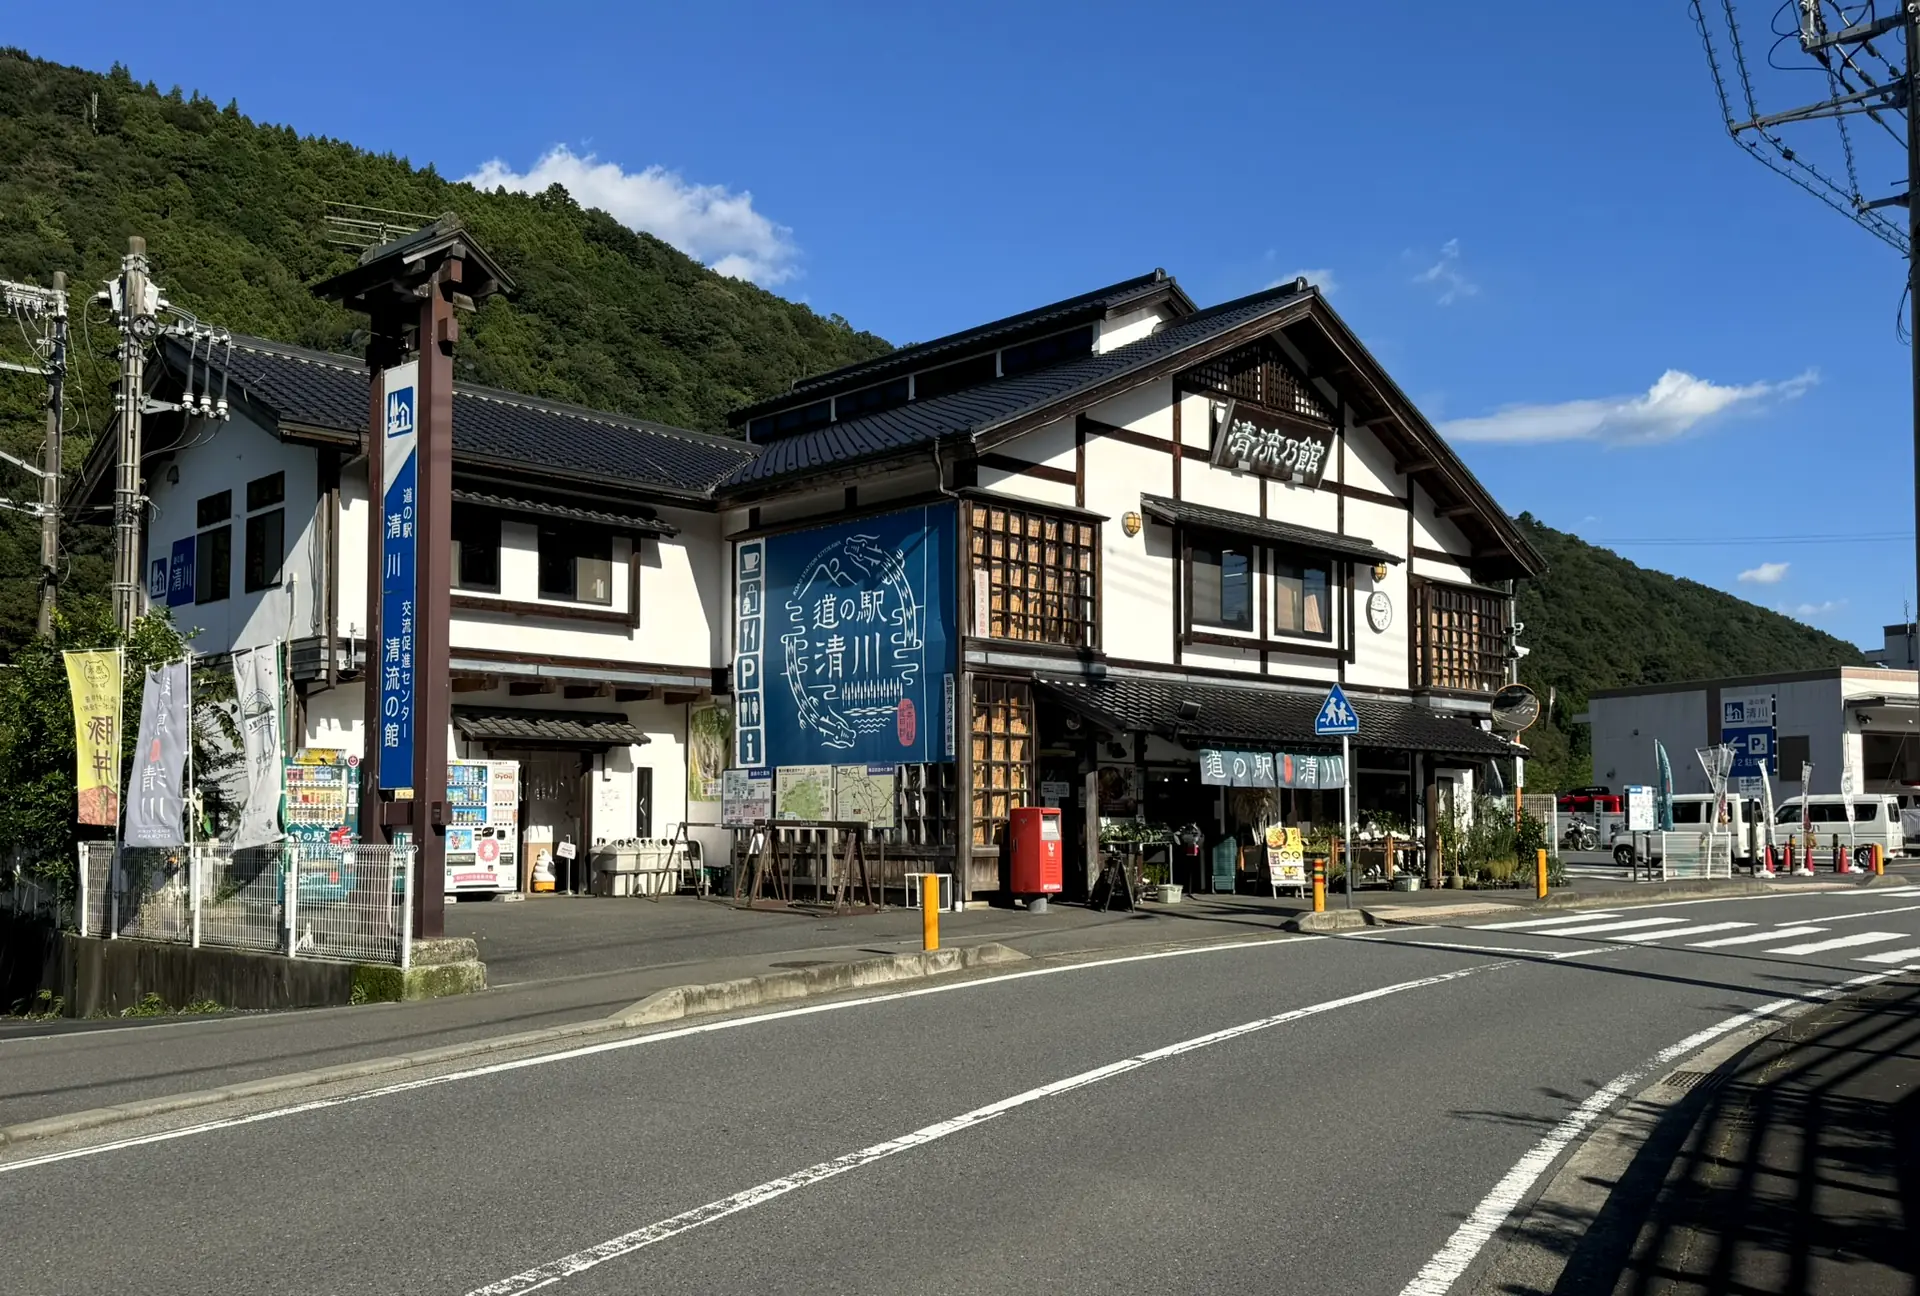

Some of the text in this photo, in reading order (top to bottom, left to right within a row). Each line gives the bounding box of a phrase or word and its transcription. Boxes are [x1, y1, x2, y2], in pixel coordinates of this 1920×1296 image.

[1226, 418, 1325, 475] 清流乃館
[402, 487, 413, 539] 道の駅
[386, 513, 402, 579] 清川
[172, 563, 192, 592] 清川
[801, 557, 819, 579] STATION
[812, 590, 888, 630] 道の駅
[401, 600, 413, 739] 交流促進センター
[743, 658, 756, 688] P
[815, 632, 881, 680] 清川
[384, 637, 401, 748] 清流の館
[1746, 707, 1768, 719] 清川
[1206, 750, 1275, 782] 道の駅
[1300, 757, 1345, 785] 清川
